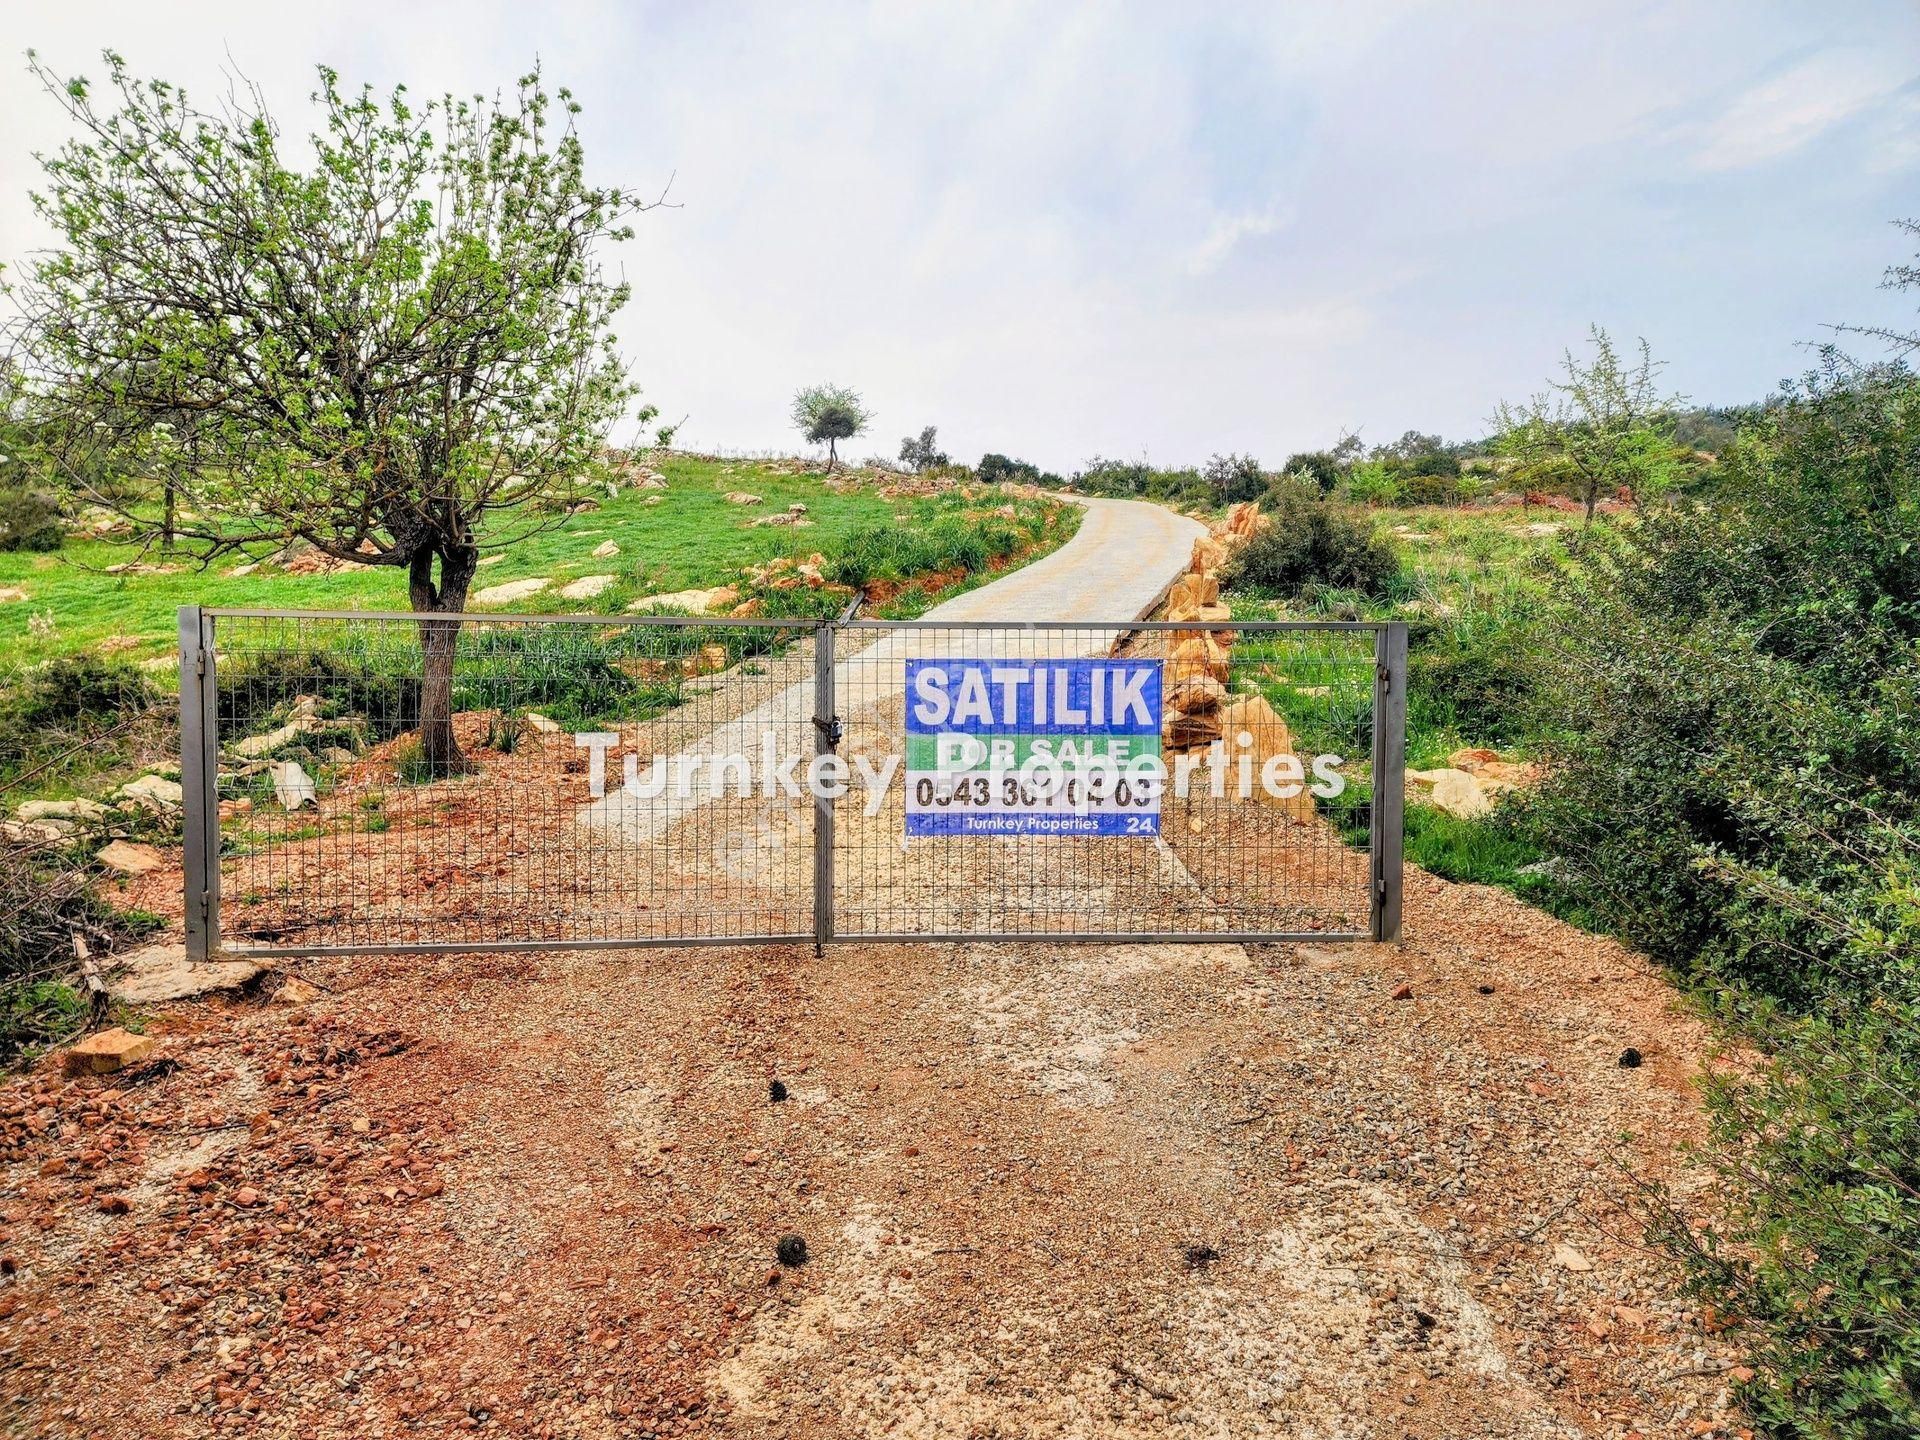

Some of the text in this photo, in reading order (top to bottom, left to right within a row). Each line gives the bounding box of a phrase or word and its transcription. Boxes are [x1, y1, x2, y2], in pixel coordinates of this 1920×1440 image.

[914, 667, 1154, 725] SATILIK
[1030, 739, 1130, 767] SALE
[967, 817, 1152, 833] Turnkey Properties 24
